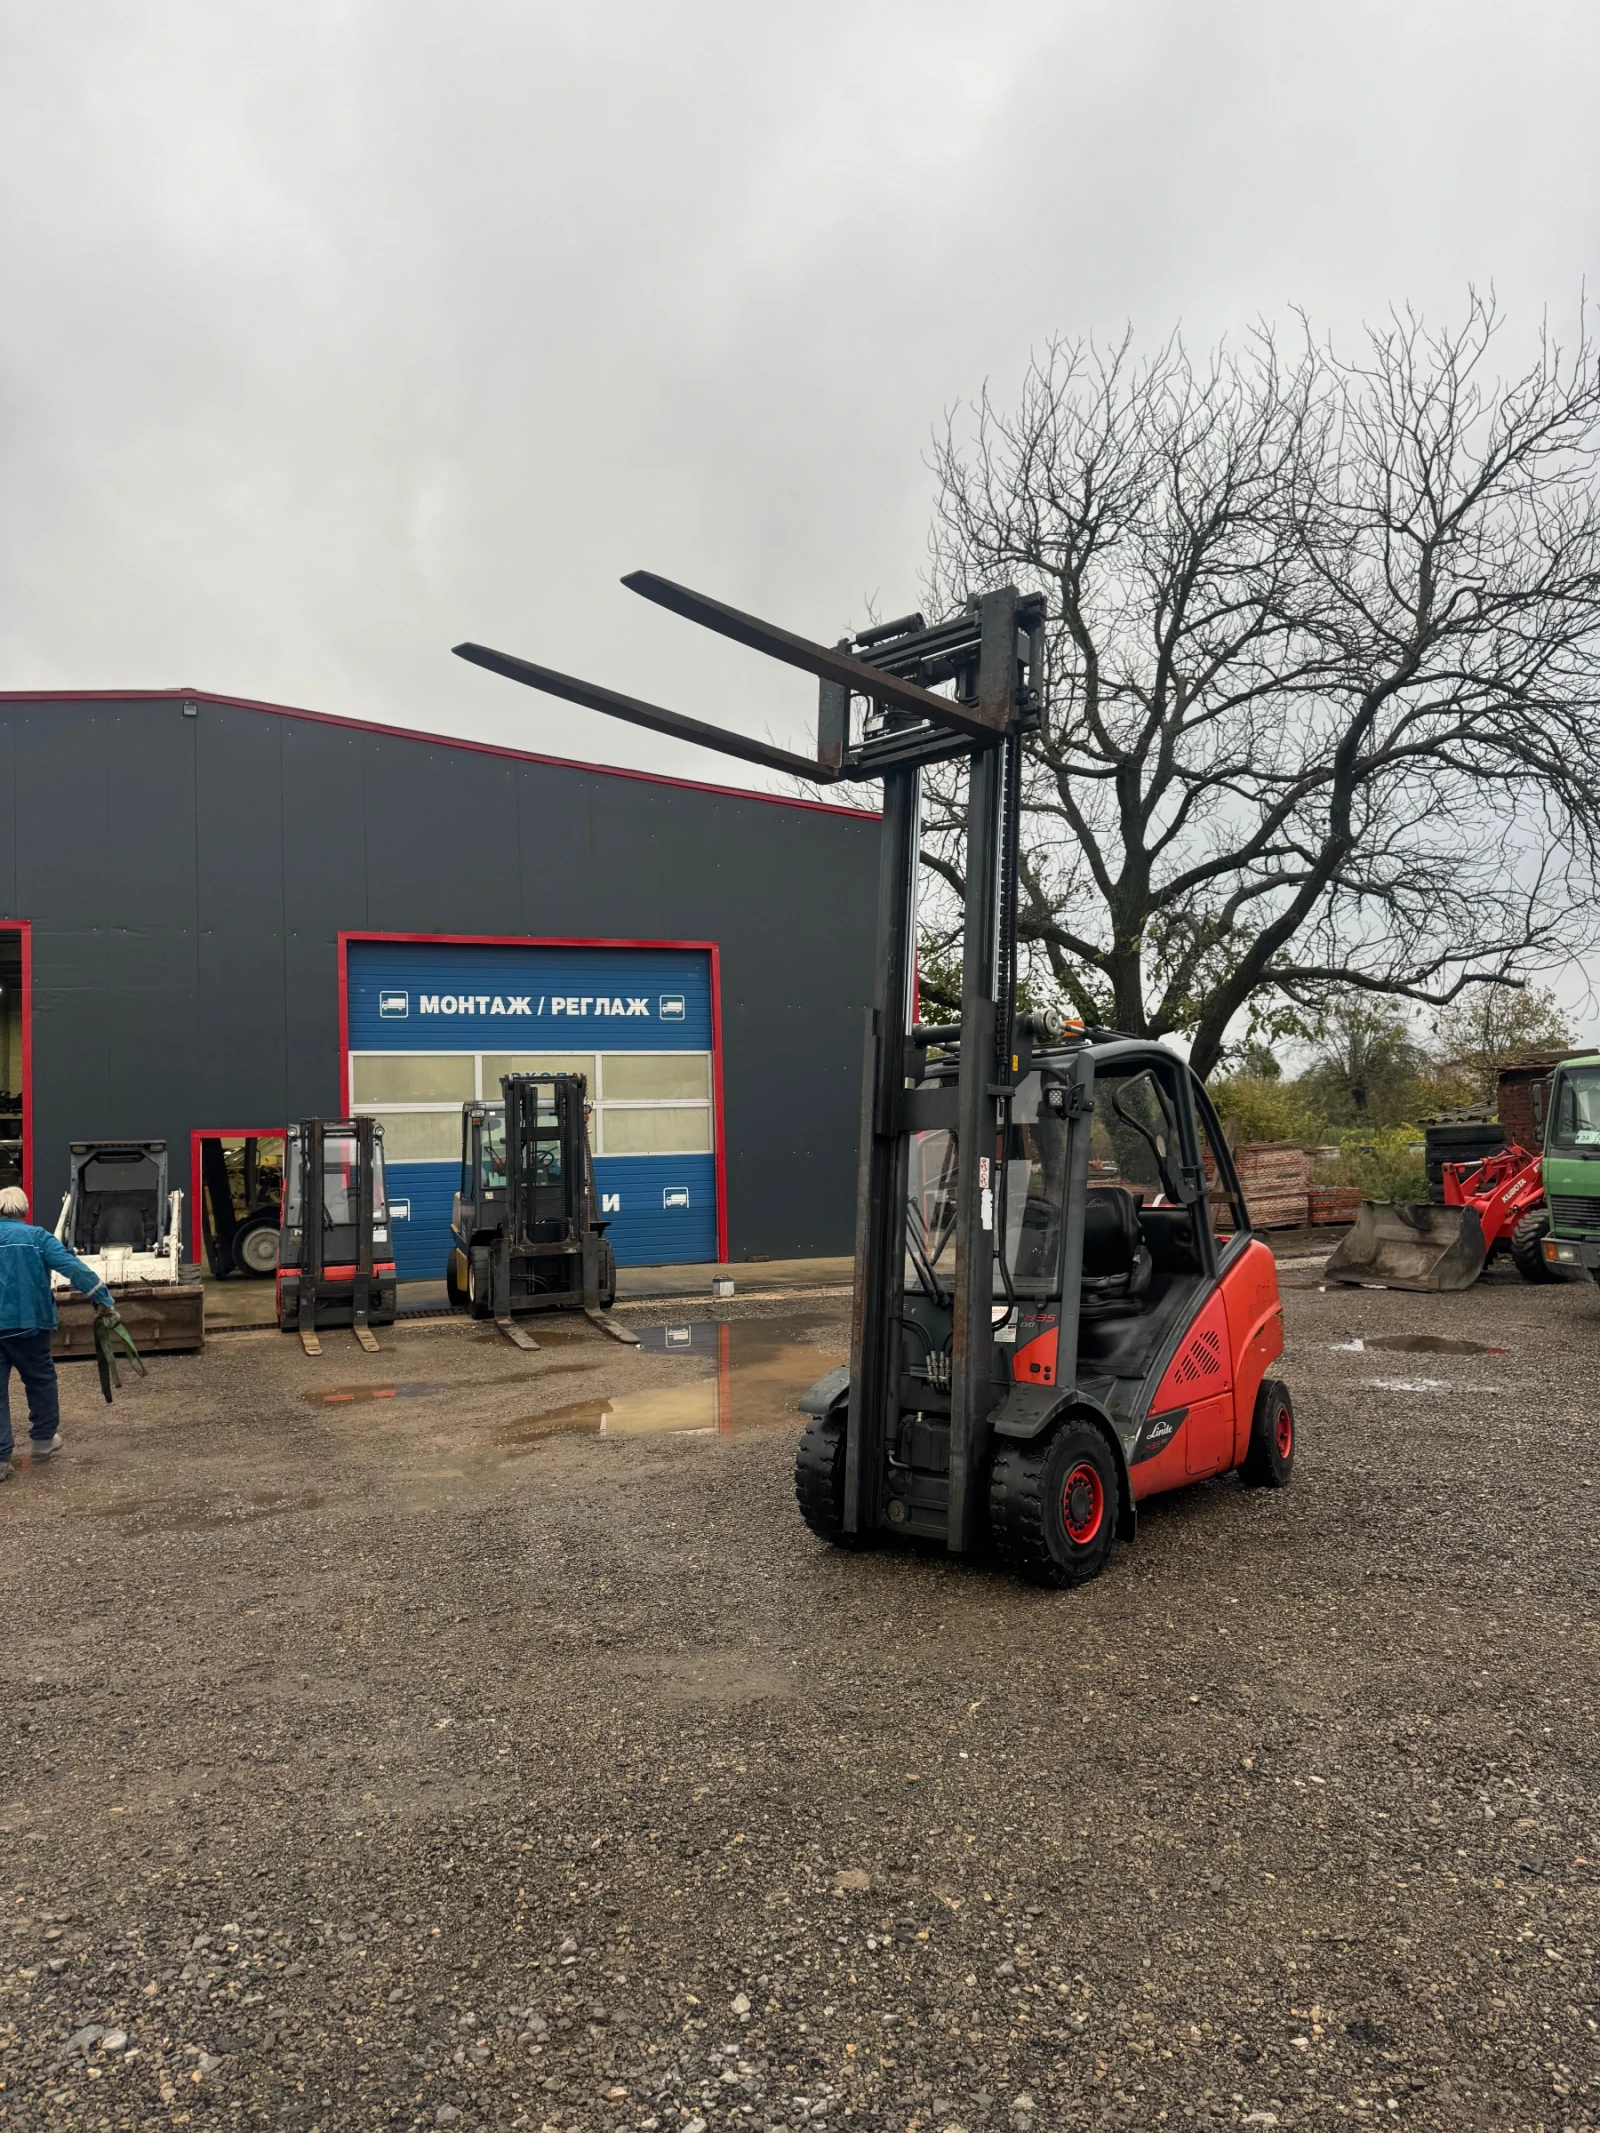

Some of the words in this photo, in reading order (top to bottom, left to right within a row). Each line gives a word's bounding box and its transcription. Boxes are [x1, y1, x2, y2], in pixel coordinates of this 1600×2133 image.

[419, 995, 533, 1015] МОНТАЖ
[537, 996, 545, 1016] /
[551, 997, 650, 1016] РЕГЛАЖ
[1502, 1178, 1527, 1203] KUBOTA
[1036, 1313, 1056, 1323] 35
[1146, 1421, 1173, 1440] Linde
